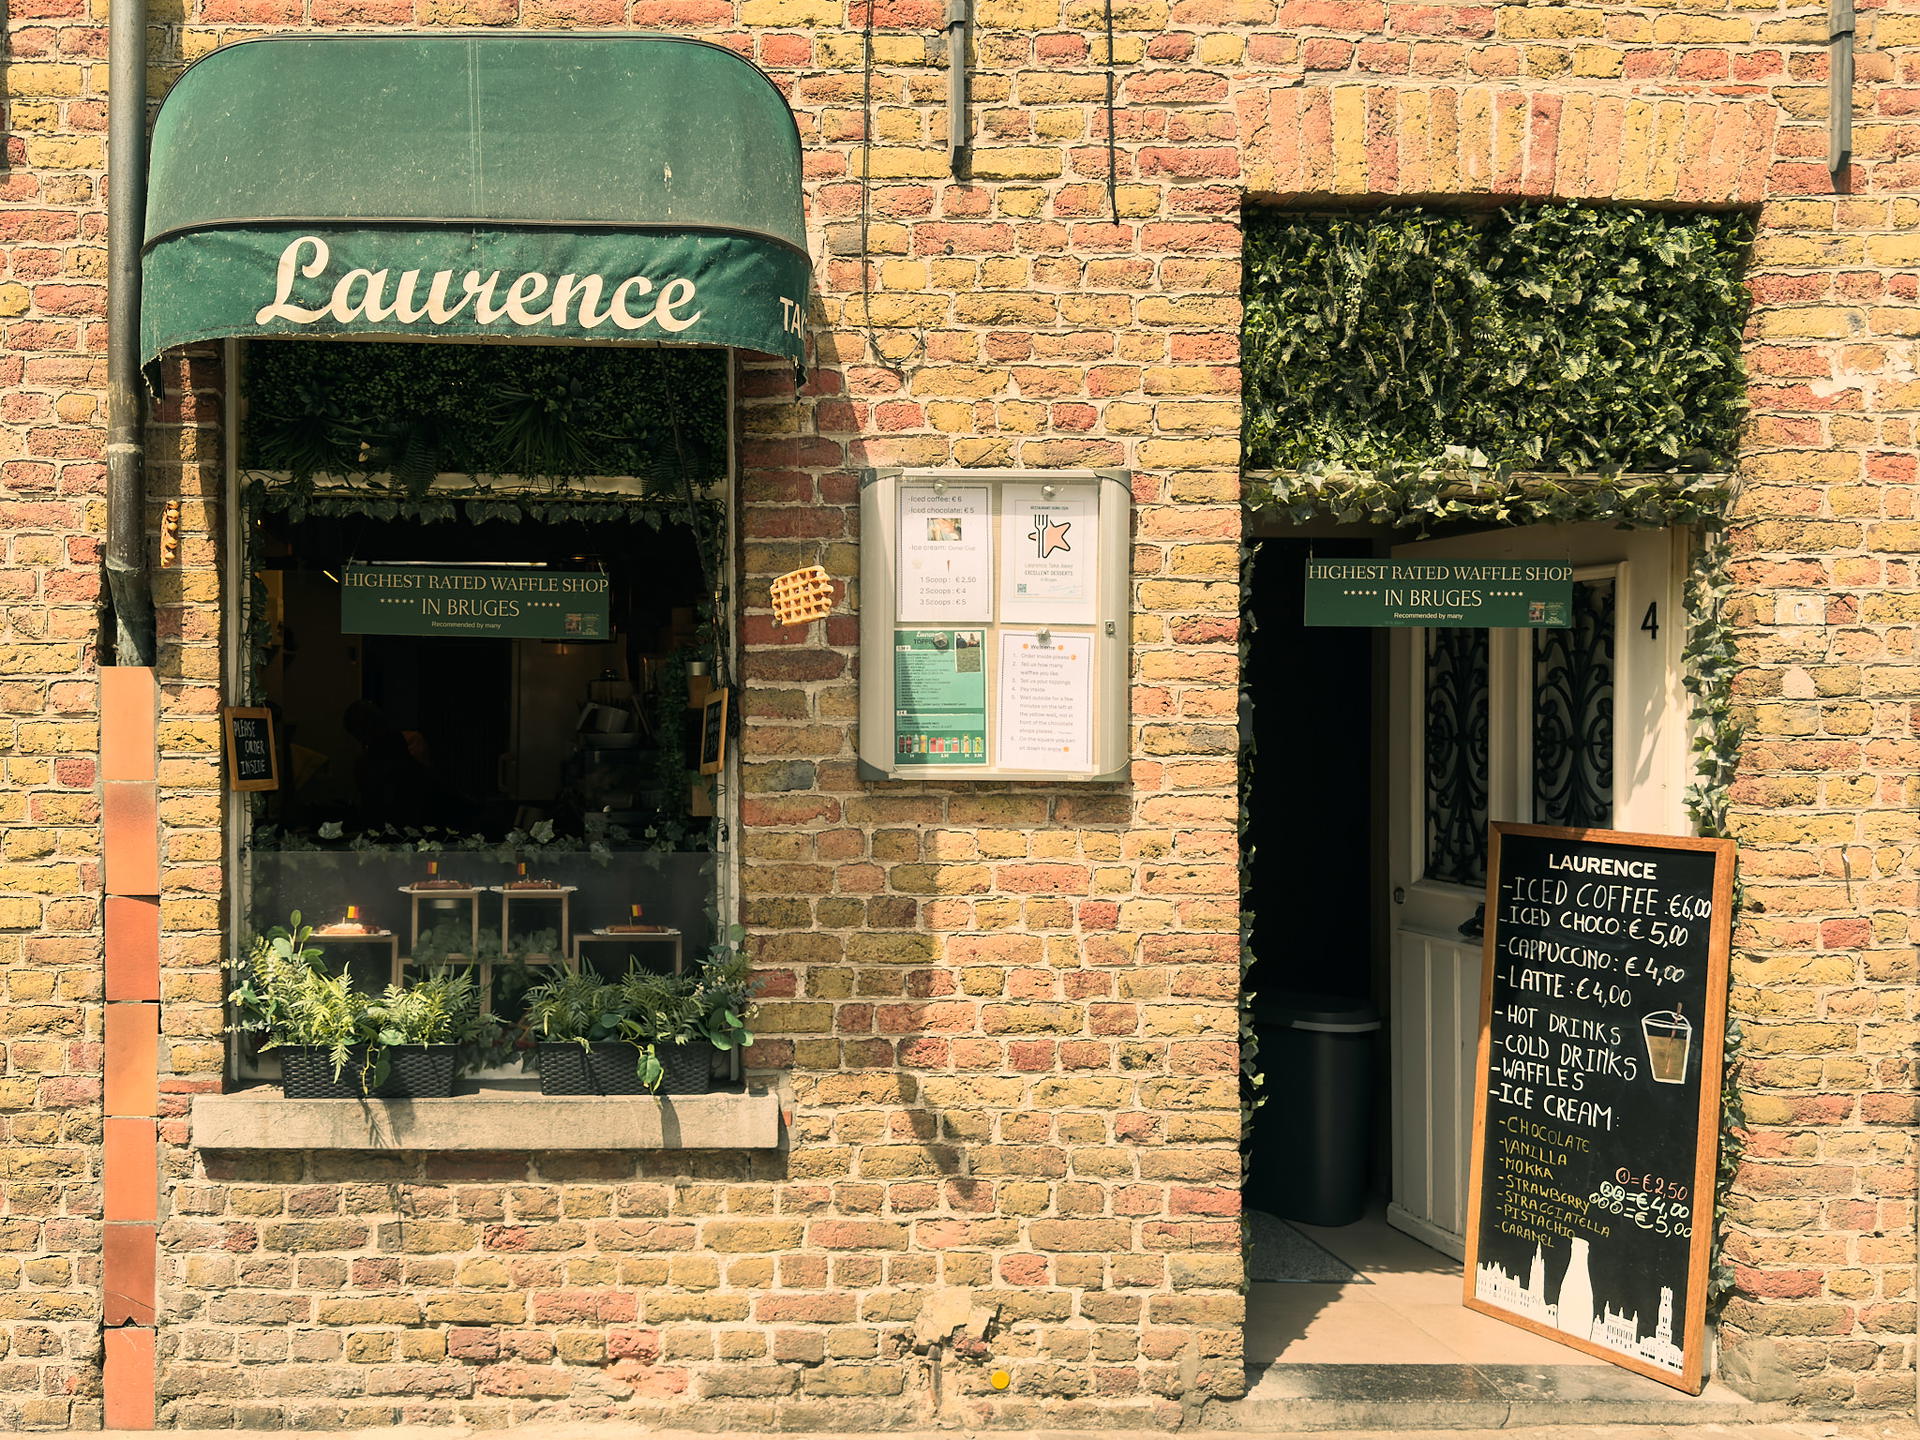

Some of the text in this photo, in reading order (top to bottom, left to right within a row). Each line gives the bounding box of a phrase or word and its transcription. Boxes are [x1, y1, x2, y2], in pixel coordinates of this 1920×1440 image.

[255, 235, 702, 332] Laurence
[344, 573, 609, 593] HIGHEST RATED WAFFLE SHOP
[1308, 565, 1573, 582] HIGHEST RATED WAFFLE SHOP
[421, 598, 520, 617] IN BRUGES
[1384, 590, 1483, 607] IN BRUGES
[431, 621, 501, 631] Recommended by many
[1393, 612, 1464, 621] Recommended by many
[1640, 600, 1660, 641] 4
[233, 720, 255, 737] PLEASE
[245, 740, 265, 754] ORDER
[240, 760, 266, 775] INSIDE
[1548, 853, 1658, 881] LAURENCE
[1576, 882, 1659, 917] COFFEE
[1549, 1012, 1622, 1046] DRINKS
[1560, 1042, 1637, 1082] DRINKS
